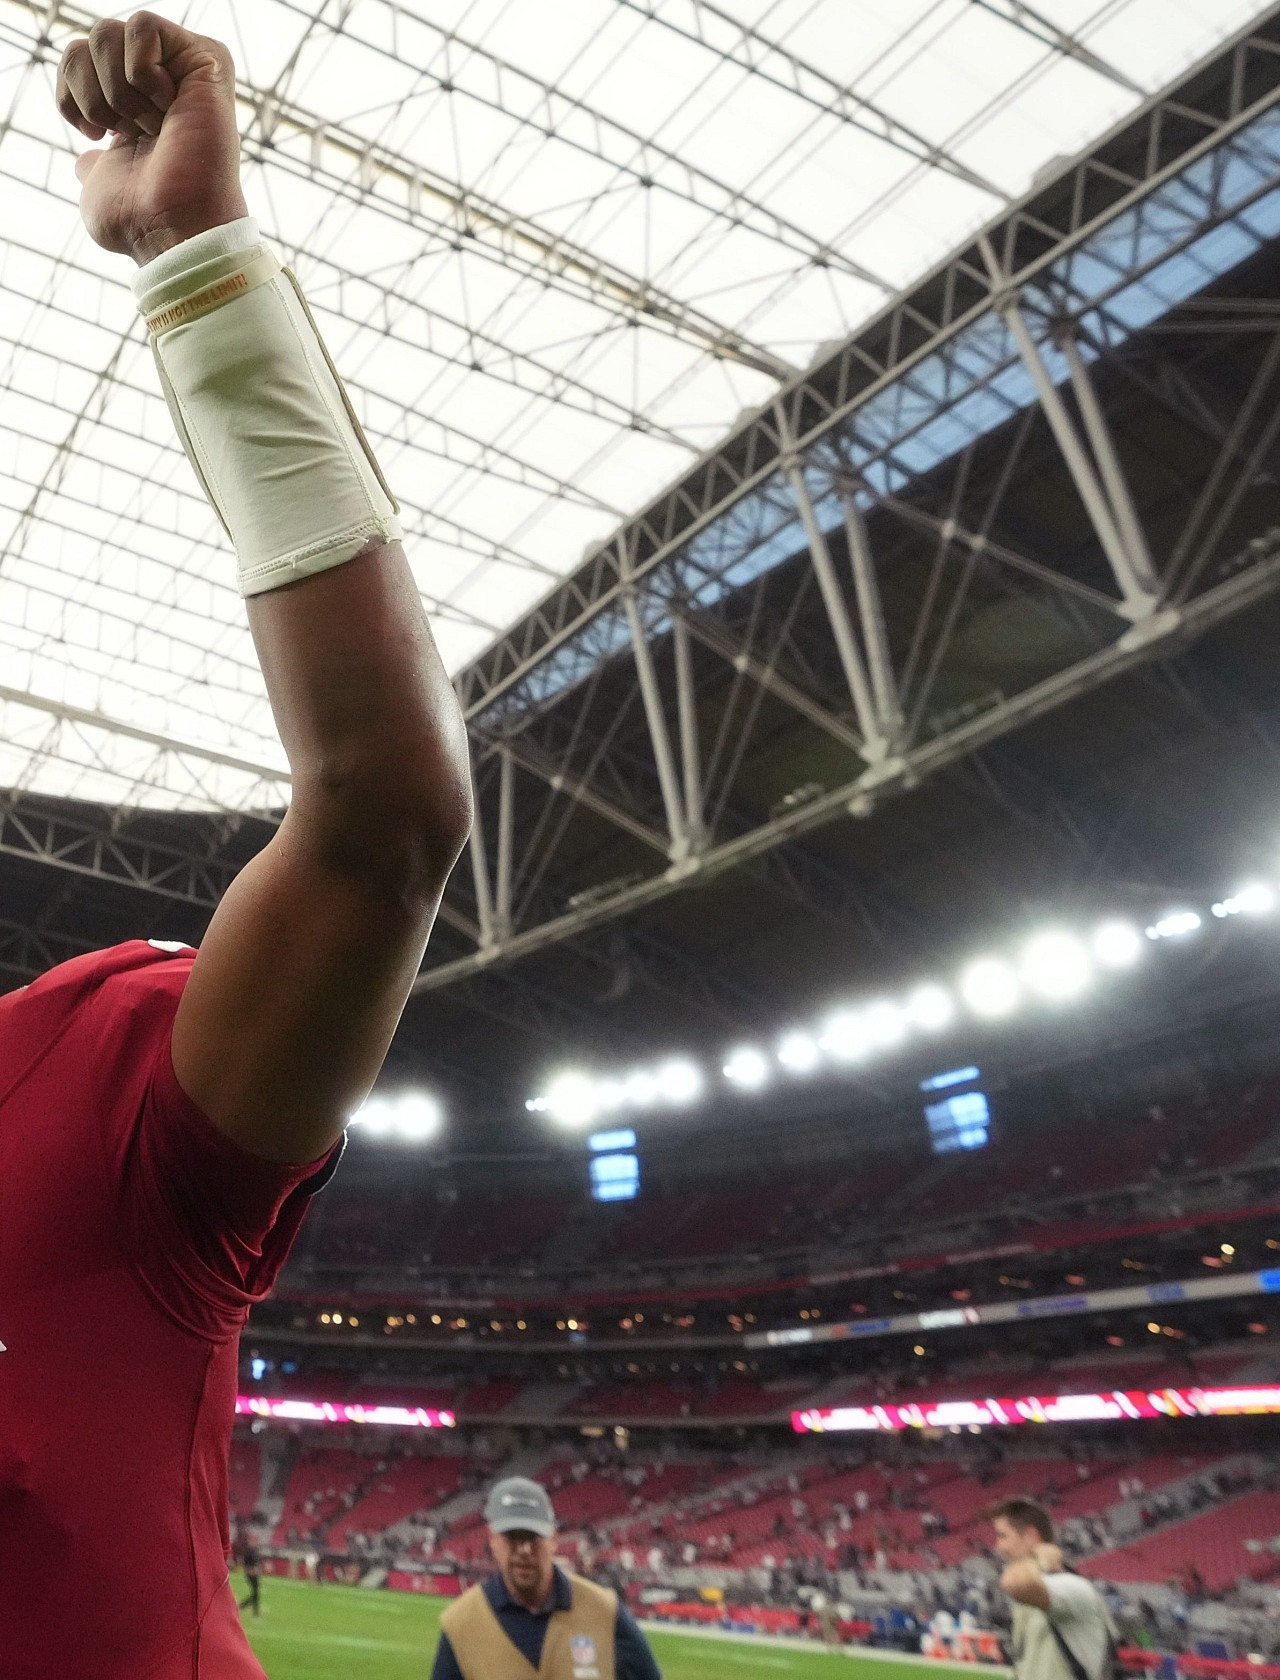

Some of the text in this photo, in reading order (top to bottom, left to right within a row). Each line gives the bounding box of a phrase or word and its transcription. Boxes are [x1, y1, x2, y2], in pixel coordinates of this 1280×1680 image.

[167, 302, 187, 322] NOT
[186, 292, 211, 312] THE
[209, 273, 248, 301] LIMIT!
